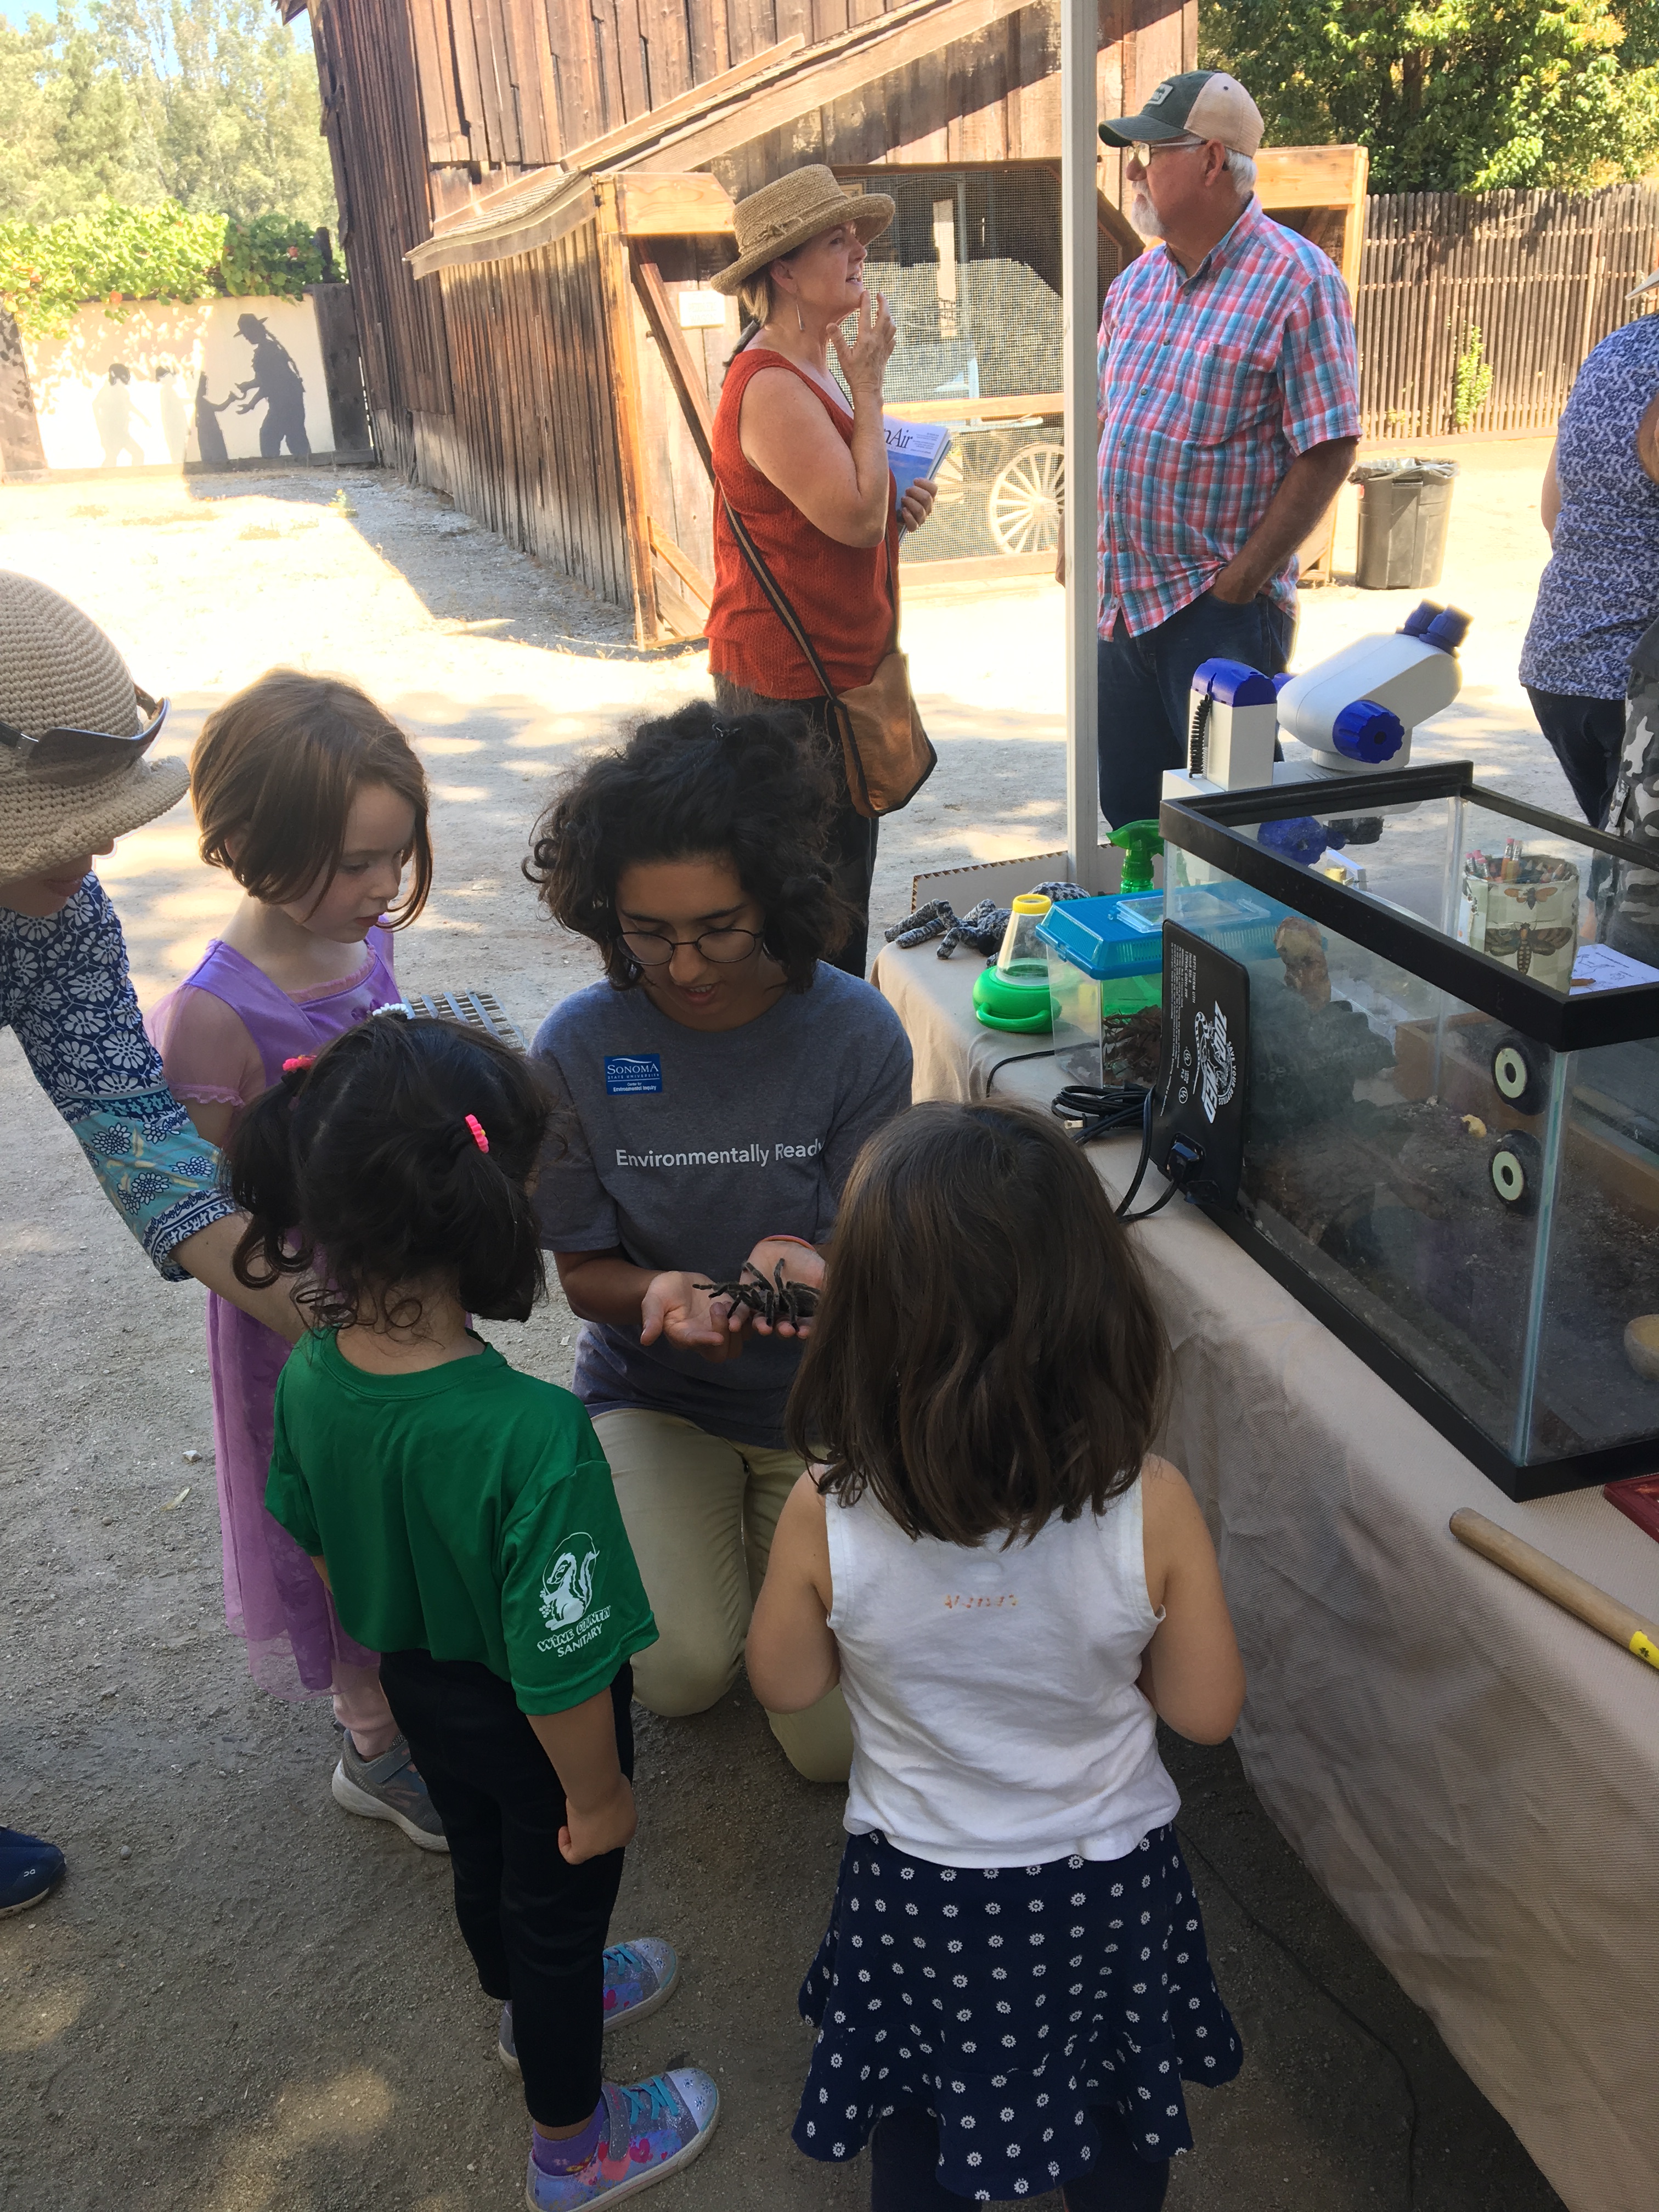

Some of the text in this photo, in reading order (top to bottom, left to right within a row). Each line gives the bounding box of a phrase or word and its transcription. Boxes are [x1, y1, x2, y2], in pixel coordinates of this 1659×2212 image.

[616, 1144, 769, 1167] Environmentally
[576, 1605, 611, 1635] COUNTRY
[557, 1623, 602, 1657] SANITARY
